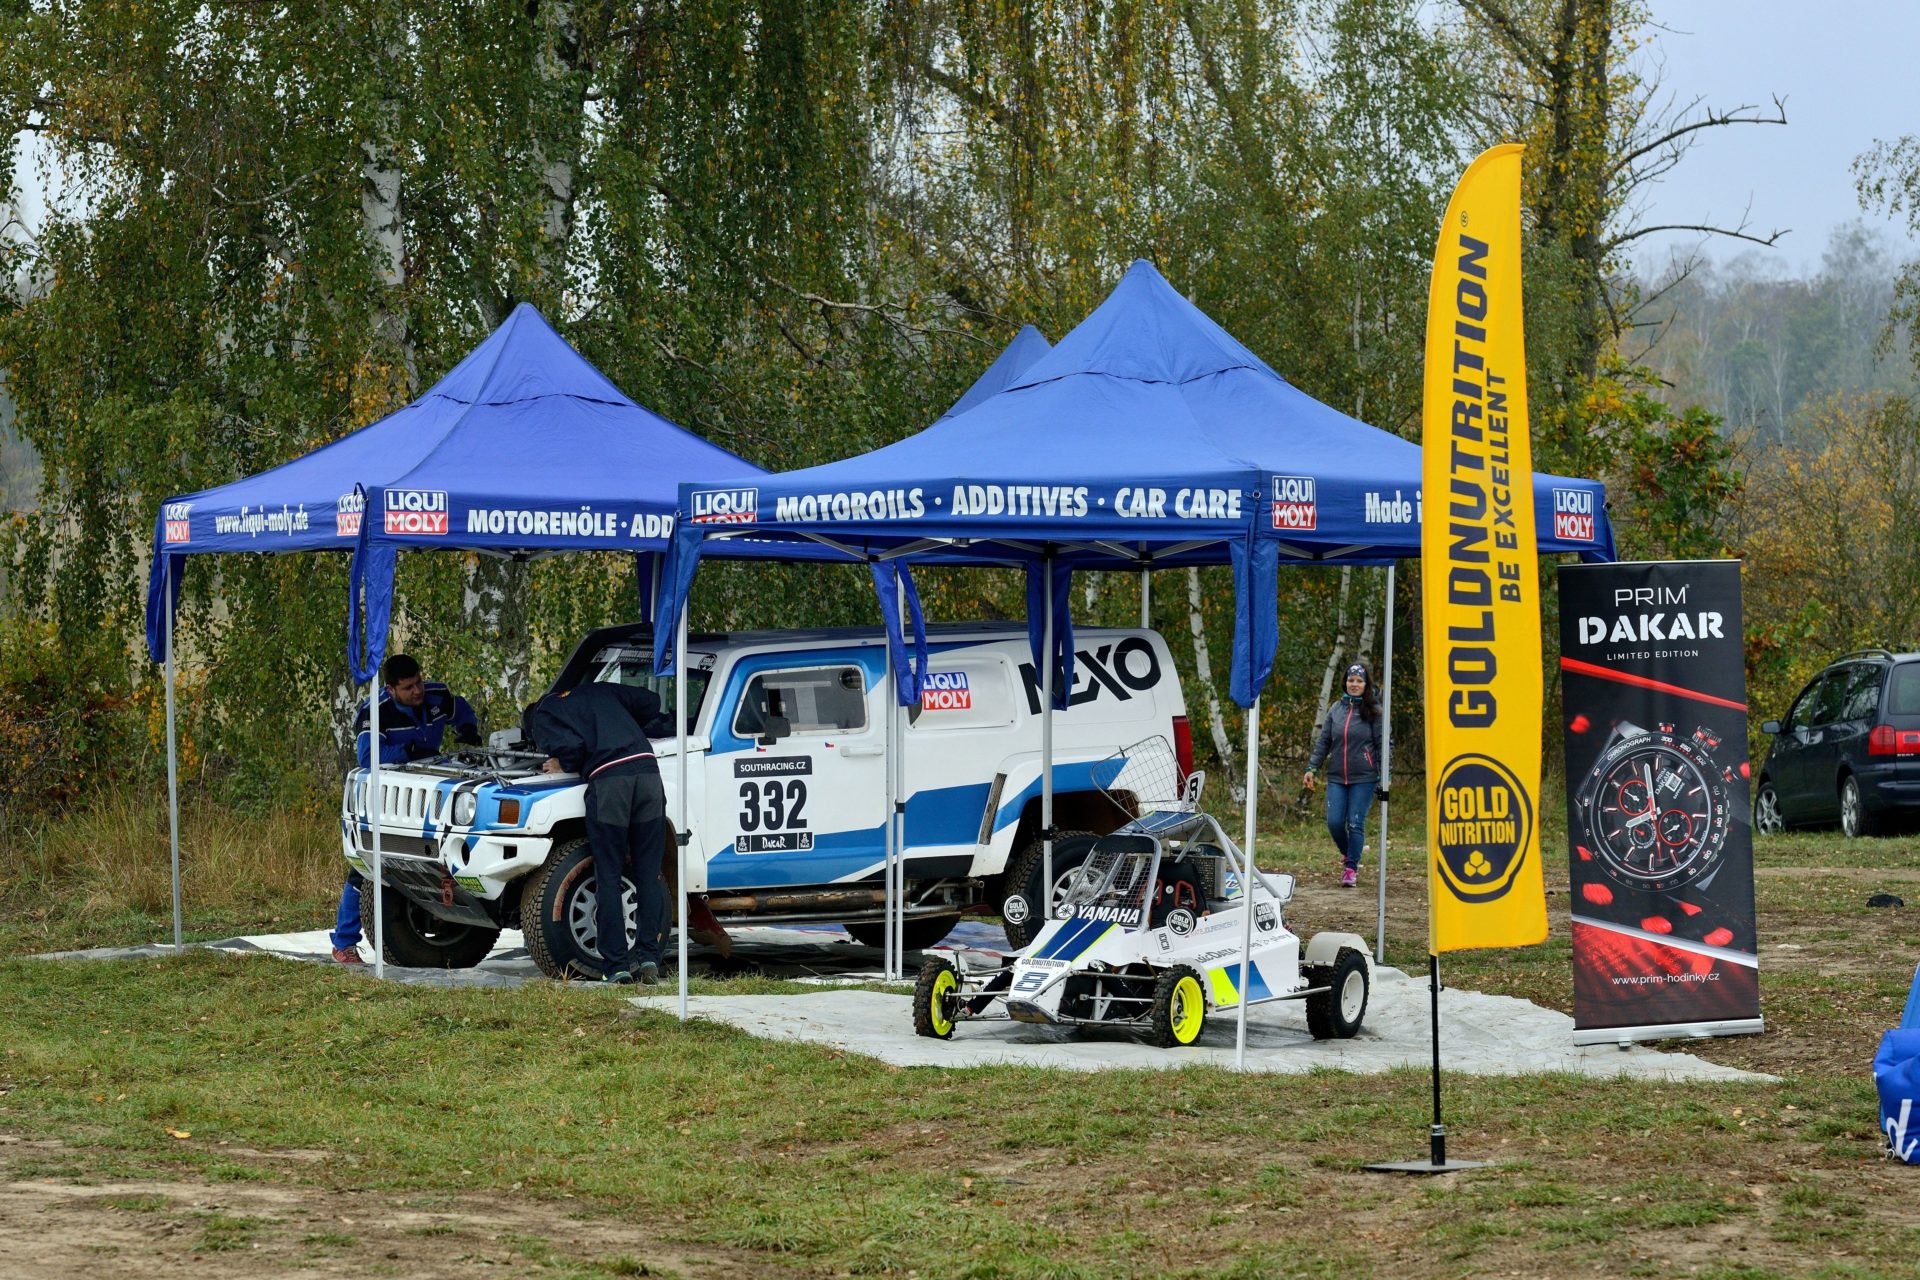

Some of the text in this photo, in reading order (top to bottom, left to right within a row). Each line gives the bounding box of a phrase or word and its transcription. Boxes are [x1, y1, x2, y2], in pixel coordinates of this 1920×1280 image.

[1274, 479, 1313, 503] LIQUI
[1448, 234, 1498, 729] GOLDNUTRITION
[1486, 368, 1521, 603] BE EXCELLENT
[165, 503, 190, 521] LIQUI
[388, 491, 445, 512] LIQUI
[695, 492, 754, 516] LIQUI
[776, 485, 1242, 521] MOTOROILS ADDITIVES CAR CARE
[1365, 489, 1411, 523] Made
[1555, 489, 1592, 514] LIQUI
[215, 504, 309, 538] www.liqui-moly.de
[387, 512, 446, 532] MOLY
[467, 506, 617, 537] MOTORENÖLE
[1273, 503, 1314, 527] MOLY
[1557, 515, 1593, 538] MOLY
[166, 521, 190, 542] MOLY
[1614, 587, 1687, 607] PRIM
[1578, 612, 1724, 645] DAKAR
[1607, 650, 1699, 661] LIMITED EDITION
[924, 672, 966, 691] LIQUI
[924, 691, 969, 709] MOLY
[1607, 736, 1651, 761] CHRONOGRAPH
[740, 761, 807, 773] SOUTHRACING.CZ
[1655, 771, 1671, 795] DAKAR
[739, 779, 808, 832] 332
[1443, 786, 1509, 820] GOLD
[1440, 821, 1516, 846] NUTRITION
[1077, 905, 1141, 924] YAMAHA
[1173, 914, 1189, 924] GOLD
[1612, 972, 1720, 986] www.prim-hodinky.cz
